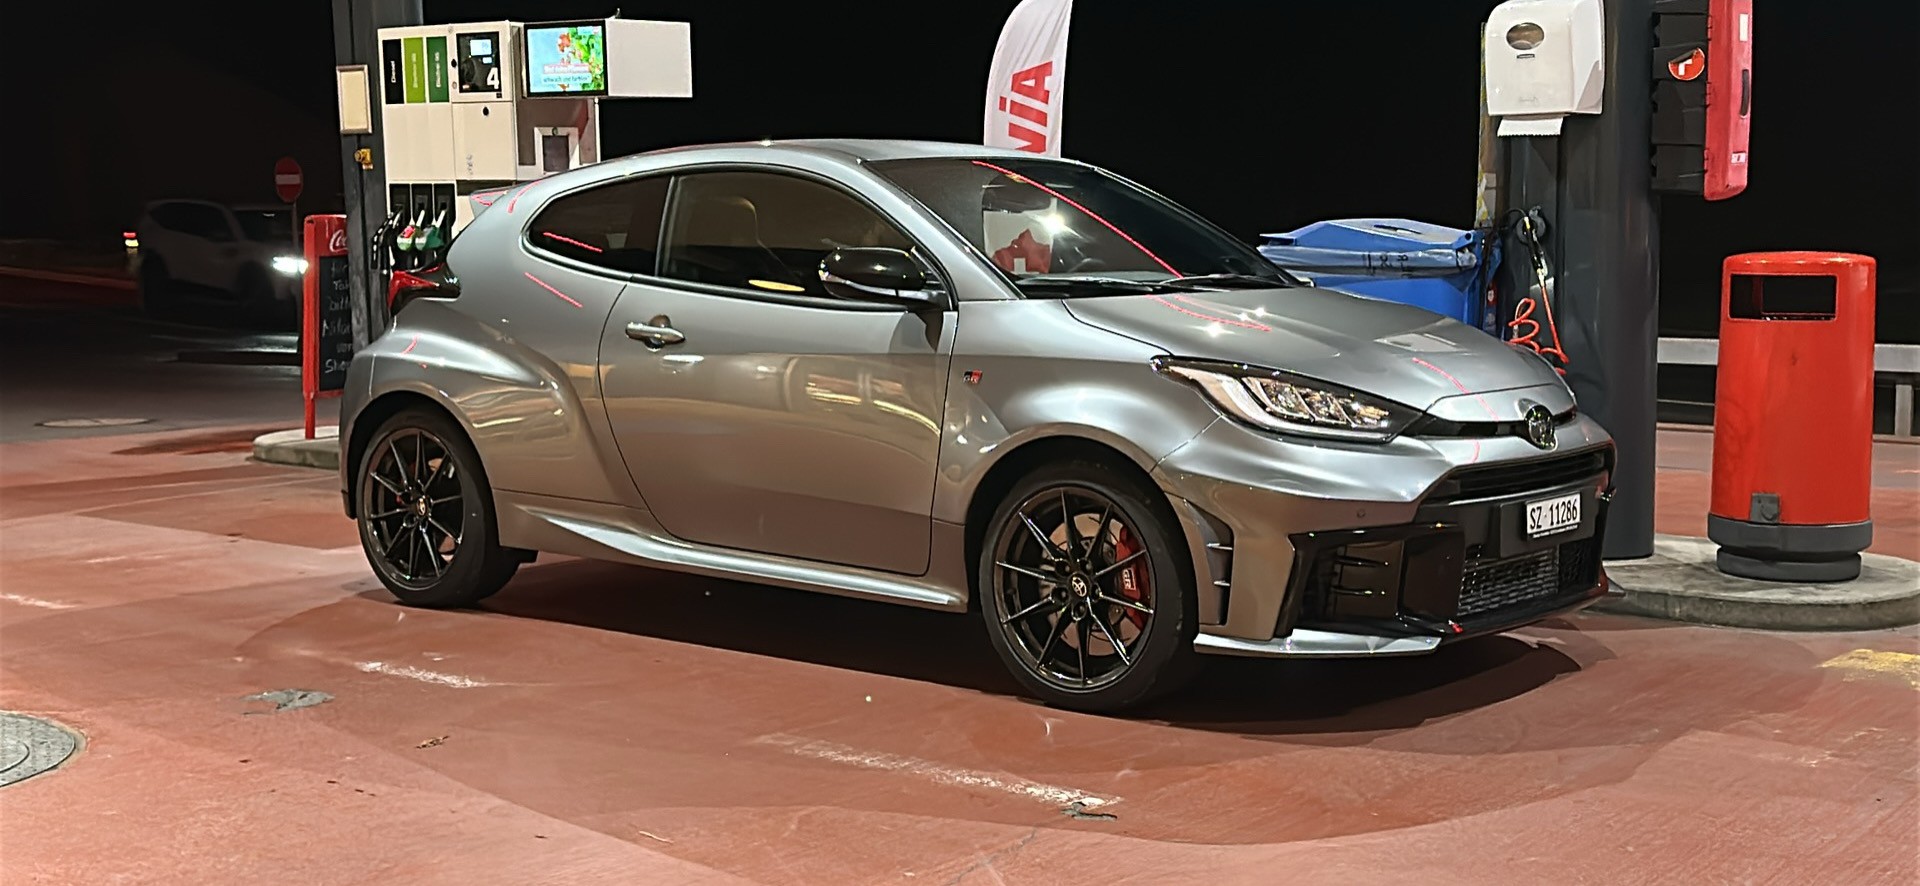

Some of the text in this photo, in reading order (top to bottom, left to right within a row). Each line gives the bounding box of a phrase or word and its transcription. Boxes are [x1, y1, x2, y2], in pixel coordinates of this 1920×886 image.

[486, 67, 499, 90] 4
[1530, 499, 1578, 530] SZ 11286
